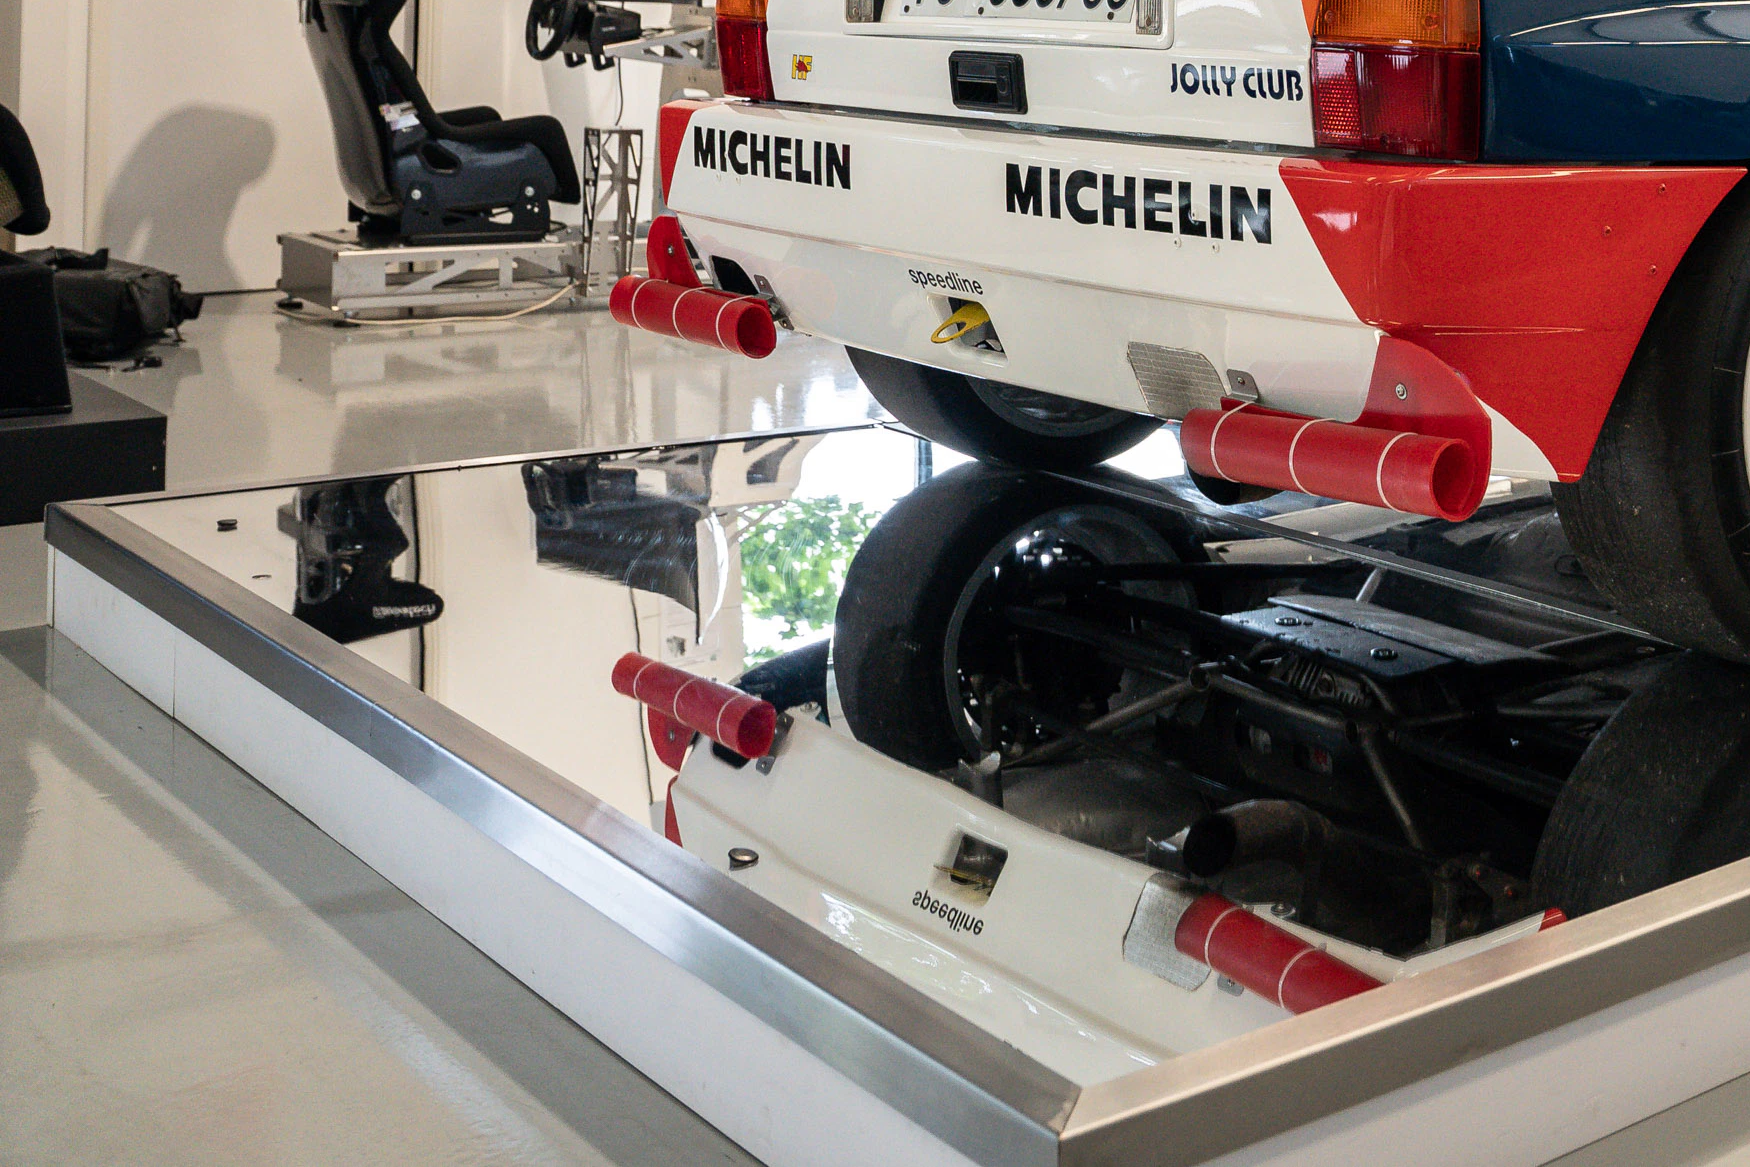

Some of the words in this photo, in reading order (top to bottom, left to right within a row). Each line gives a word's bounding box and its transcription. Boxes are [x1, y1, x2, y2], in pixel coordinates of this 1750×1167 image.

[791, 54, 813, 80] HF
[1170, 63, 1237, 97] JOLLY
[1243, 67, 1304, 102] CLUB
[693, 125, 851, 190] MICHELIN
[1004, 162, 1273, 245] MICHELIN
[908, 265, 984, 296] speedline
